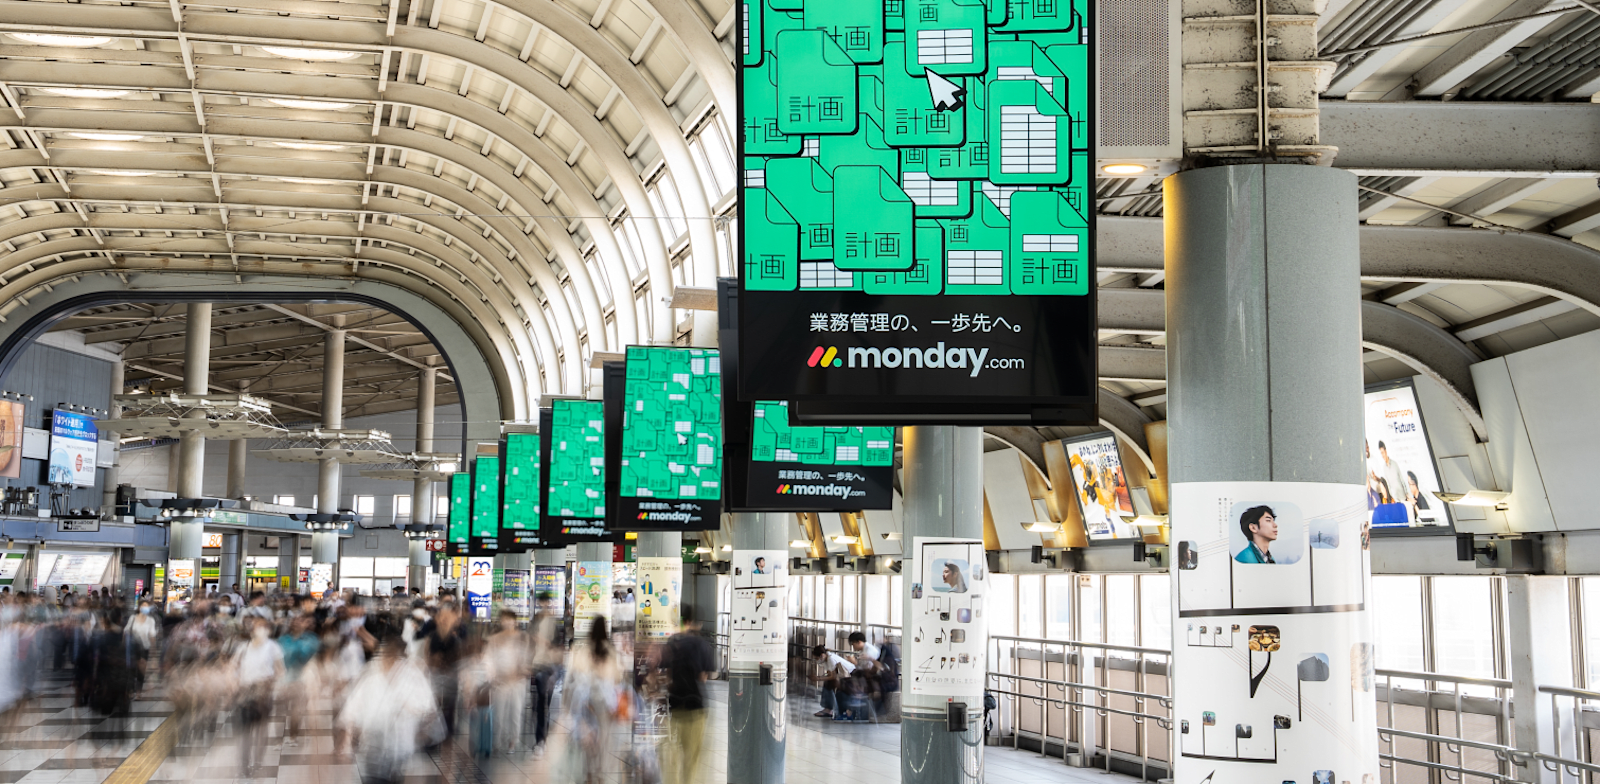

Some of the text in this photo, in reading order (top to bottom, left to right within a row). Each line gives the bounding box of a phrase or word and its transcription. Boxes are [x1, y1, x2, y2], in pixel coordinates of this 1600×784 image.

[789, 96, 844, 122] 計画
[895, 108, 950, 135] 計画
[845, 232, 901, 258] 計画
[1022, 258, 1078, 284] 計画
[809, 312, 1022, 333] 業務管理の、一歩先へ。
[848, 341, 1025, 377] monday.com
[1393, 421, 1416, 434] Future
[795, 437, 819, 449] 計画
[866, 450, 890, 462] 計画
[778, 470, 866, 482] 業務管理の、一歩先へ。
[793, 483, 866, 499] monday.com
